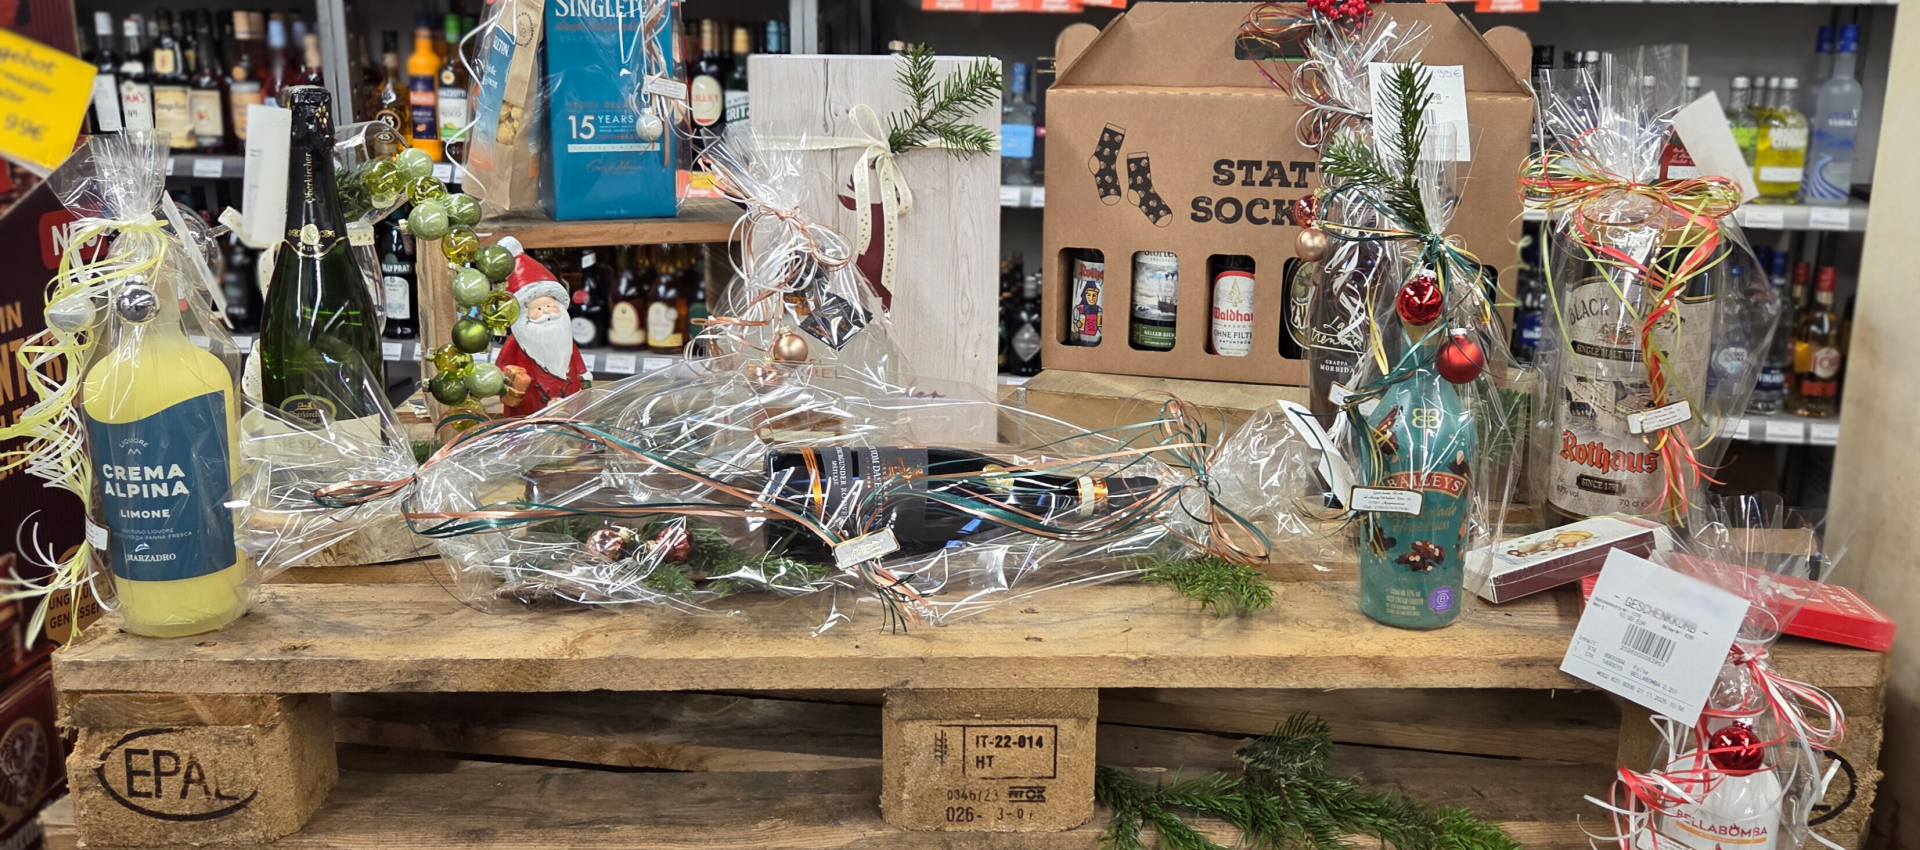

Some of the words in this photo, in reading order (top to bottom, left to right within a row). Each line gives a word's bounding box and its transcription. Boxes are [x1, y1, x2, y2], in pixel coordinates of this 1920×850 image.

[568, 115, 595, 140] 15
[598, 115, 634, 124] YEARS
[1213, 159, 1316, 188] STAT
[1191, 195, 1301, 226] SOCK
[1325, 359, 1348, 367] GRAPPA
[119, 437, 149, 448] LIQUORE
[1560, 429, 1660, 474] Rothaus
[102, 463, 186, 481] CREMA
[104, 480, 190, 498] ALPINA
[1581, 477, 1603, 490] SINCE
[1619, 499, 1630, 507] 70
[120, 508, 171, 519] LIMONE
[145, 533, 167, 541] PANNA
[168, 531, 193, 539] FRESCA
[126, 553, 176, 562] MARZADRO
[1623, 595, 1698, 634] GESCHENKKORB
[1635, 618, 1646, 627] EUR
[1586, 645, 1597, 653] STK
[1632, 664, 1649, 675] Folie
[1584, 651, 1594, 659] STK
[1629, 670, 1661, 687] BELLABOMBA
[1636, 688, 1667, 704] 27.11.2025
[975, 735, 1044, 749] IT-22-014
[975, 755, 994, 769] HT
